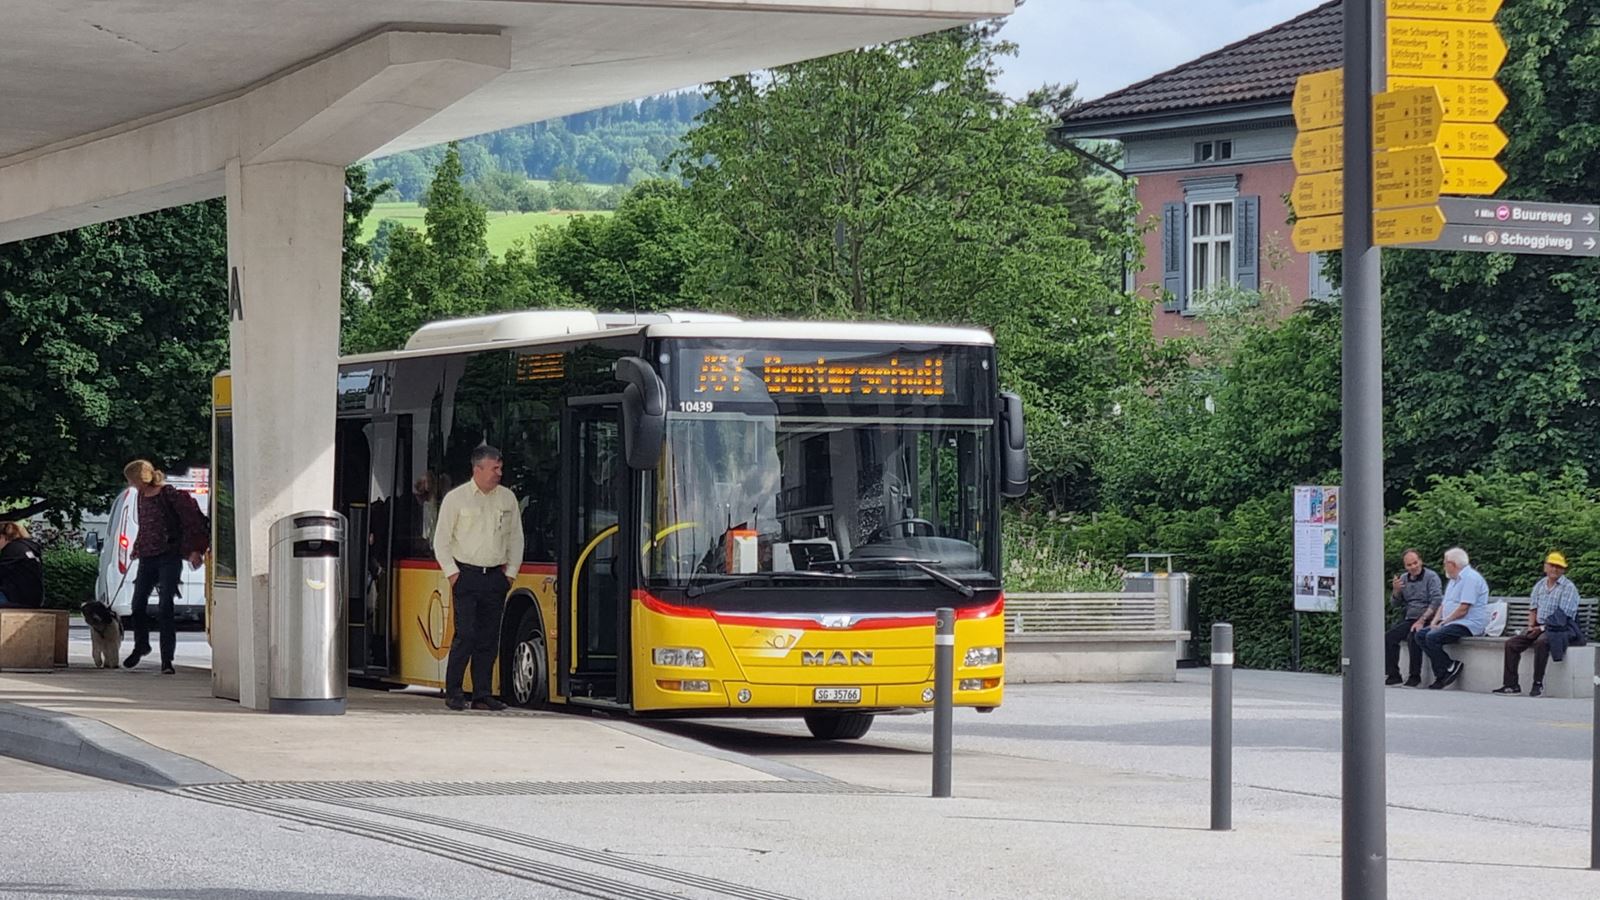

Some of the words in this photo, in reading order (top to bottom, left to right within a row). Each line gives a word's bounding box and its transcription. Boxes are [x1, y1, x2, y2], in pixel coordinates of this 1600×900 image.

[1512, 207, 1572, 225] Buureweg
[1500, 231, 1573, 250] Schoggiweg
[229, 266, 244, 321] A
[679, 401, 713, 413] 10439
[801, 651, 874, 666] MAN
